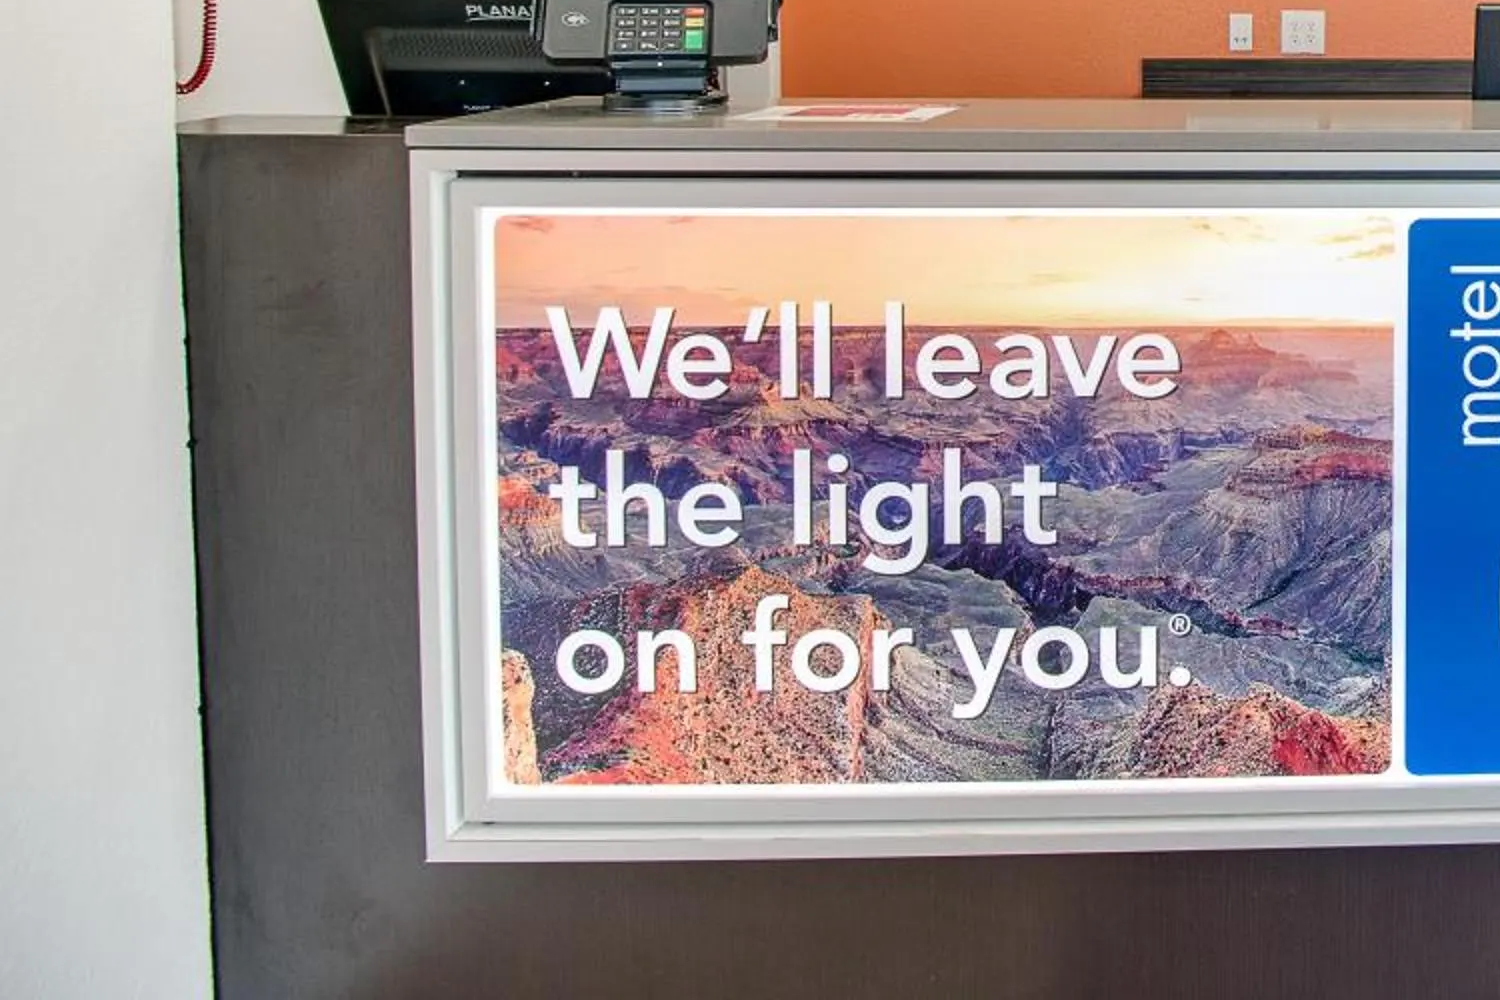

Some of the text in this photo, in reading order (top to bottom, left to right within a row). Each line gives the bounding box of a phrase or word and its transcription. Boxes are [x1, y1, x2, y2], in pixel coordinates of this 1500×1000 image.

[465, 4, 534, 19] PLANA
[546, 301, 1182, 400] We’ll leave
[548, 447, 1058, 575] the light
[555, 626, 698, 694] on
[742, 595, 916, 692] for
